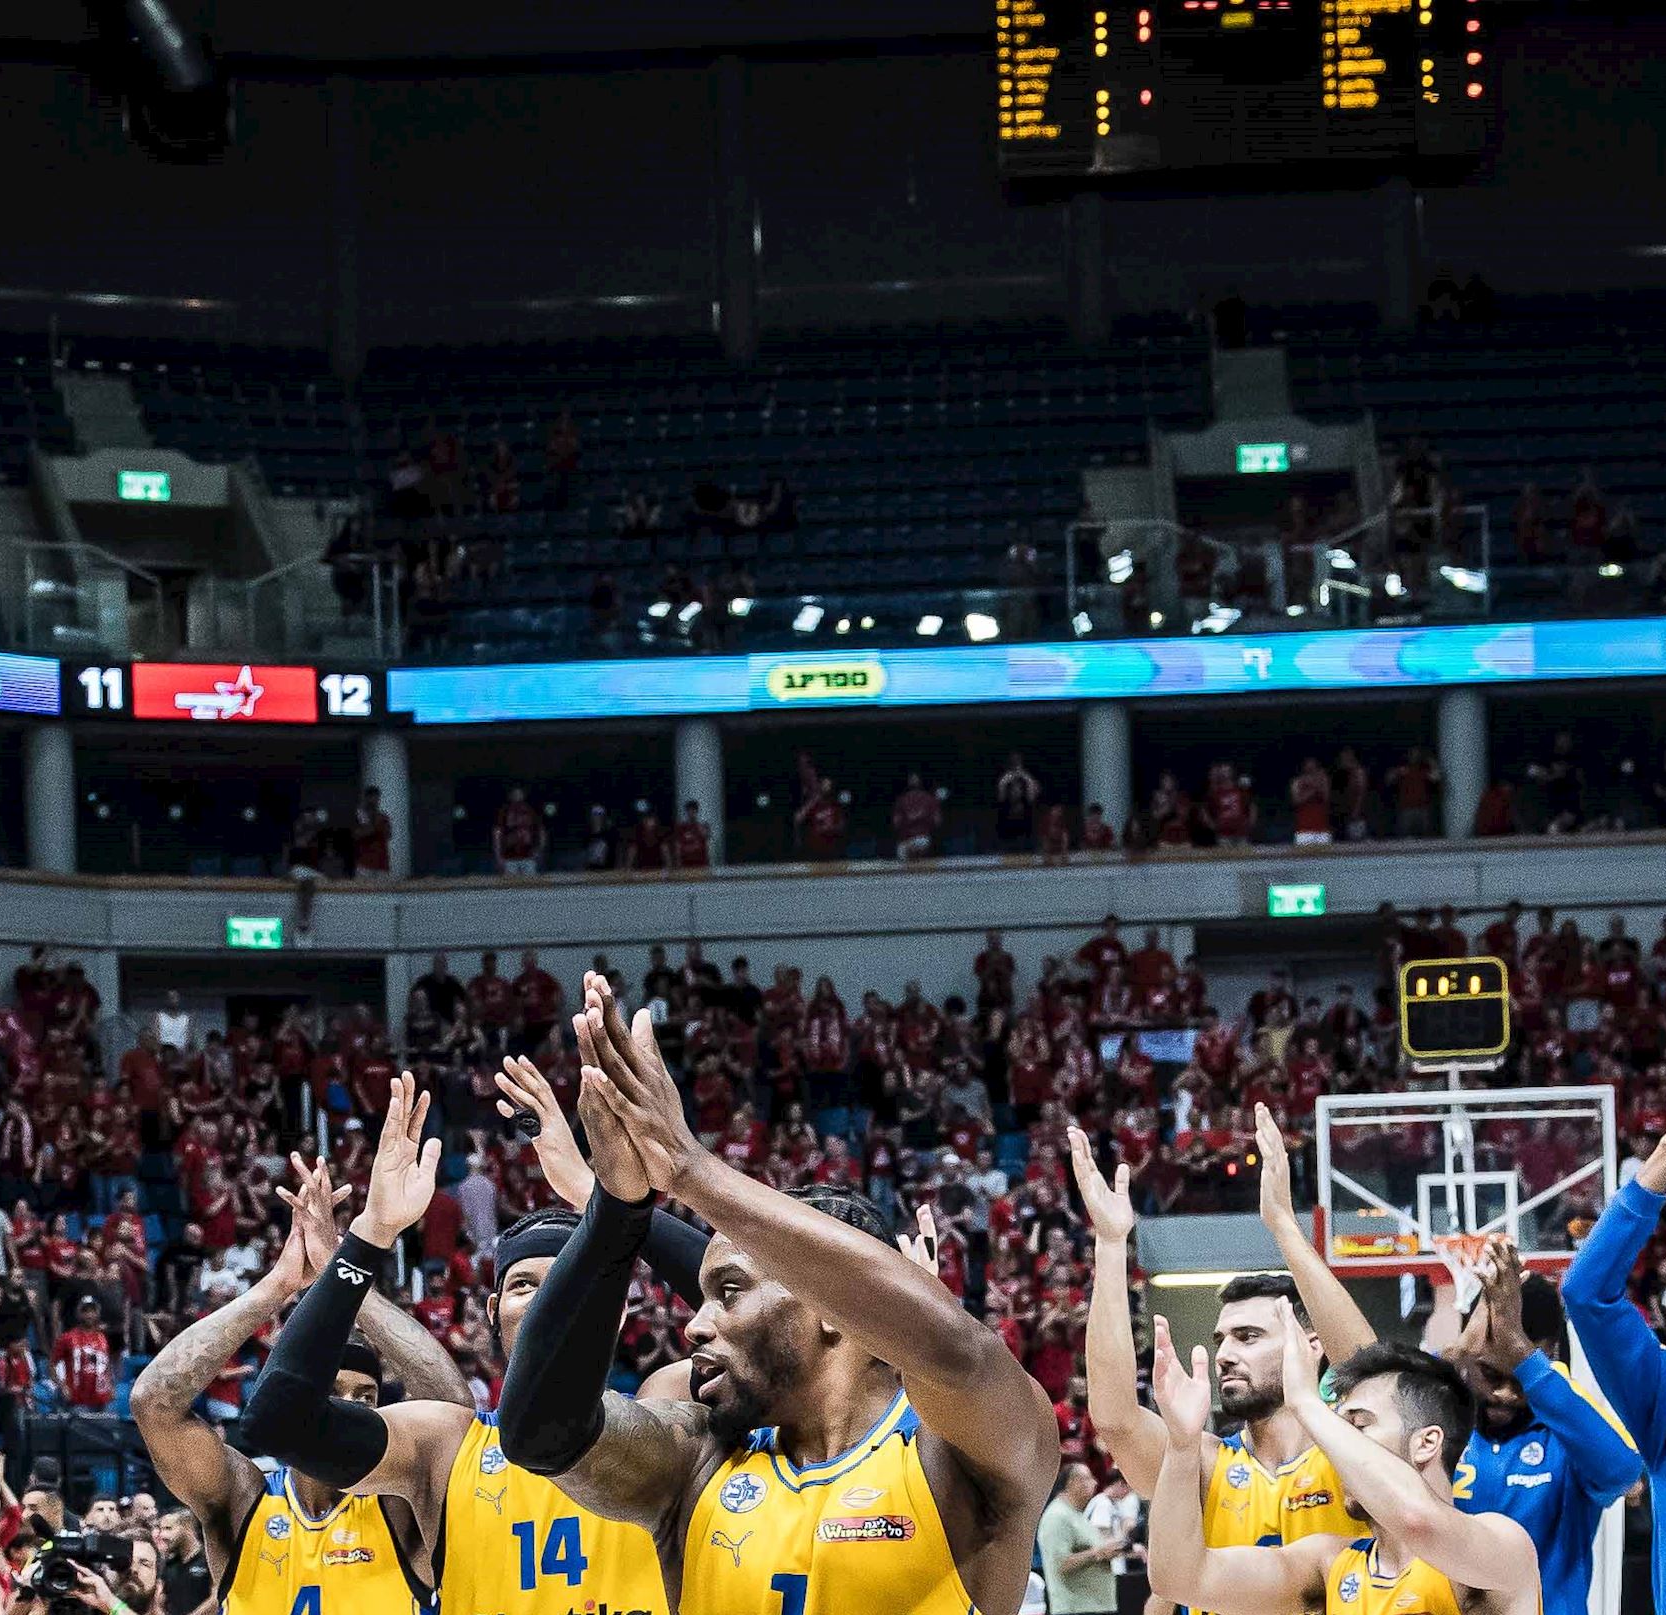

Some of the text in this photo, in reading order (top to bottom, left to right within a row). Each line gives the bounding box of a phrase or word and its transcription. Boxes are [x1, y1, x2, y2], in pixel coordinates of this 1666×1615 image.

[79, 666, 124, 710] 11
[320, 673, 372, 716] 12
[784, 671, 868, 689] ספרינג
[823, 1523, 886, 1540] Winner
[512, 1517, 588, 1590] 14
